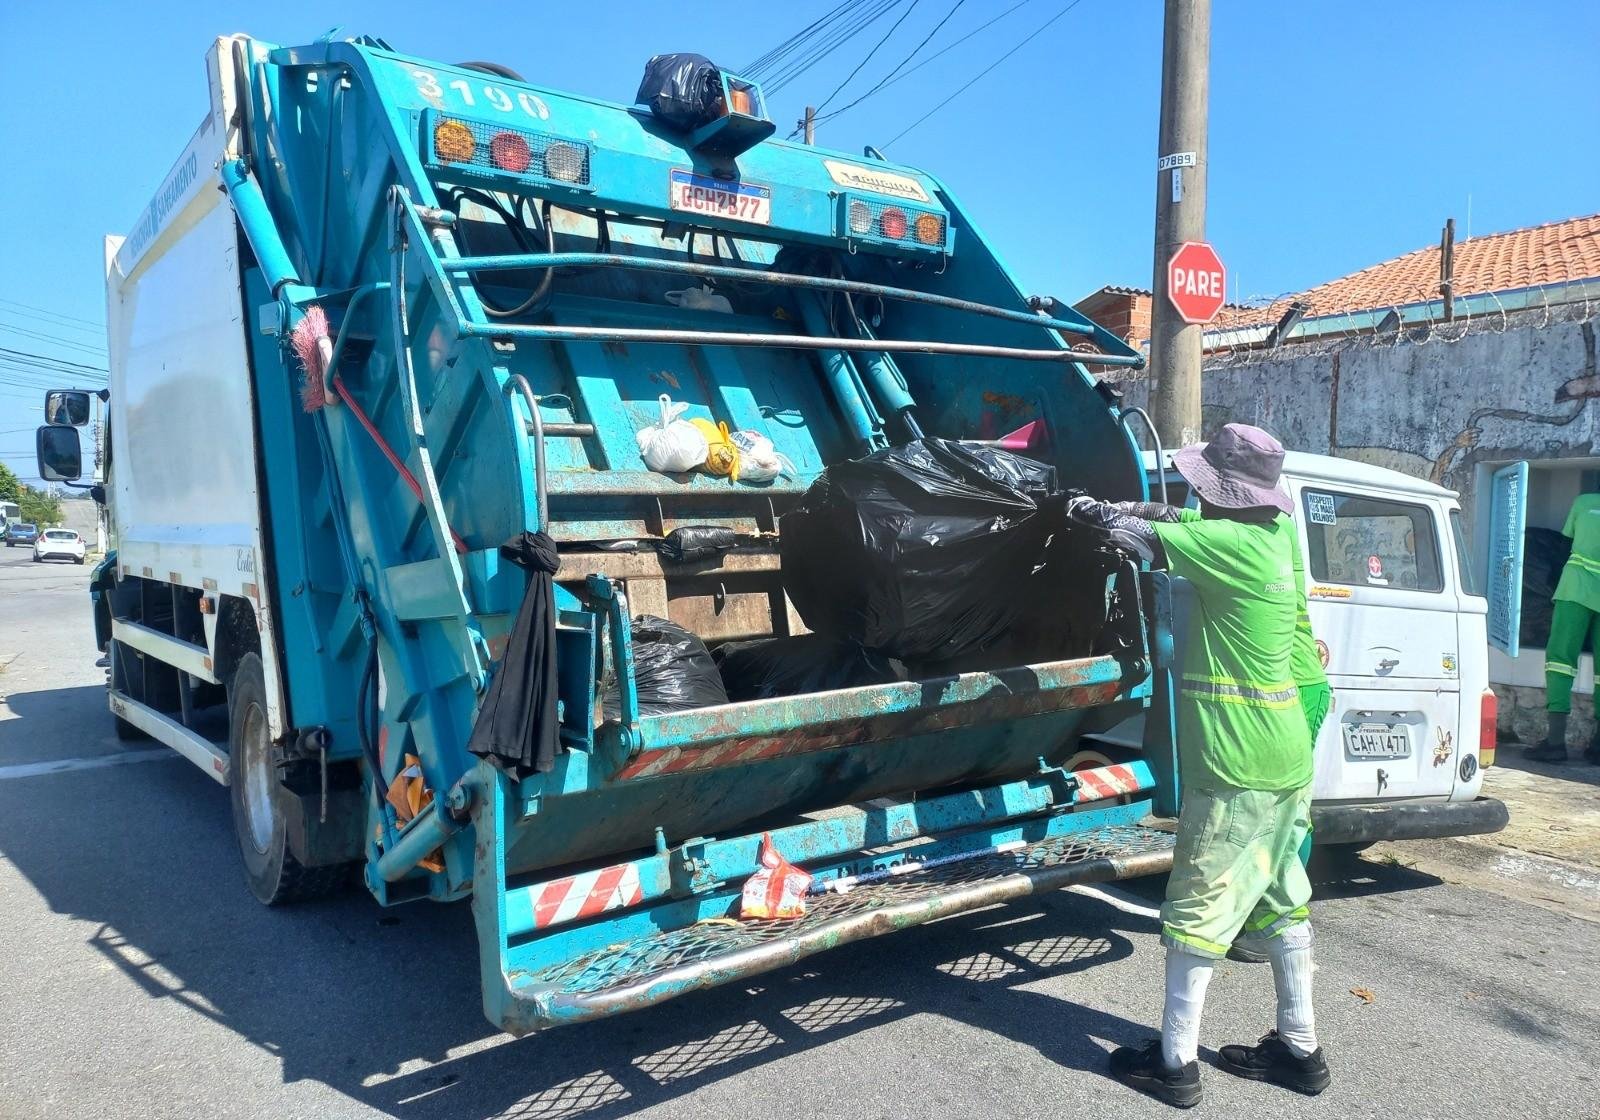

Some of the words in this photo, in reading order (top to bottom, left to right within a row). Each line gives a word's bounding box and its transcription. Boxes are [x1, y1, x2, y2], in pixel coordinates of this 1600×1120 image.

[412, 70, 550, 121] 3190
[682, 185, 760, 219] GCH7B77
[1174, 267, 1222, 299] PARE
[1309, 494, 1333, 506] RESPEITE
[1320, 504, 1334, 515] MAIS
